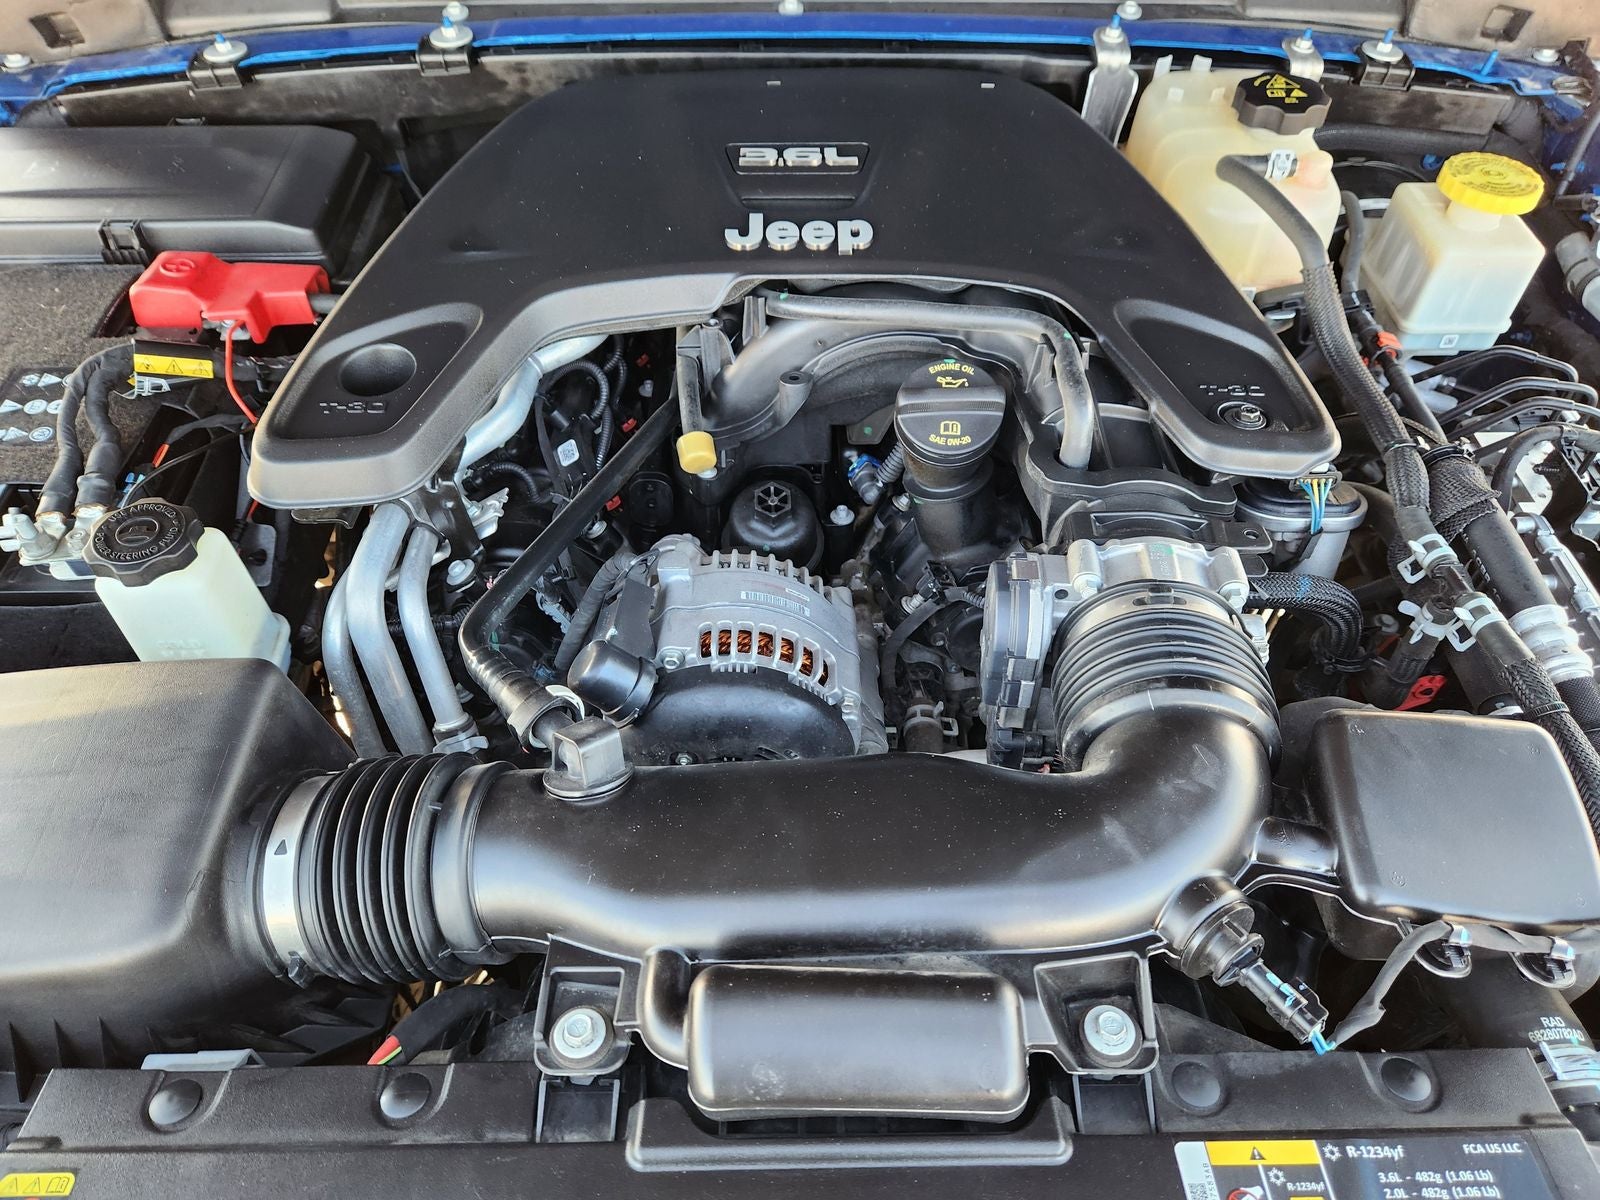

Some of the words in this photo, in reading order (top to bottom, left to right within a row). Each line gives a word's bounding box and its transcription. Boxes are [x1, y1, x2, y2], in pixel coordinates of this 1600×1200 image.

[739, 147, 859, 167] 3.6L
[724, 213, 874, 255] Jeep
[928, 363, 961, 375] ENGINE
[961, 365, 975, 375] OIL
[929, 434, 947, 445] SAE
[947, 435, 972, 446] 0W-20
[108, 511, 127, 522] USE
[130, 504, 176, 518] APPROVED
[95, 532, 111, 557] POWER
[111, 546, 158, 560] STEERING
[159, 526, 179, 548] FLUID
[1540, 1016, 1566, 1027] RAD
[1345, 1144, 1405, 1160] R-1234yf
[1463, 1144, 1486, 1154] FCA
[1487, 1144, 1501, 1154] US
[1502, 1143, 1523, 1154] LLC
[1377, 1172, 1403, 1183] 3.6L
[1415, 1171, 1444, 1184] 482g
[1445, 1170, 1476, 1183] (1.06
[1477, 1169, 1494, 1183] Lb)
[1383, 1188, 1409, 1199] 2.0L
[1420, 1187, 1450, 1199] 482g
[1452, 1187, 1483, 1199] (1.06
[1483, 1186, 1501, 1199] Lb)
